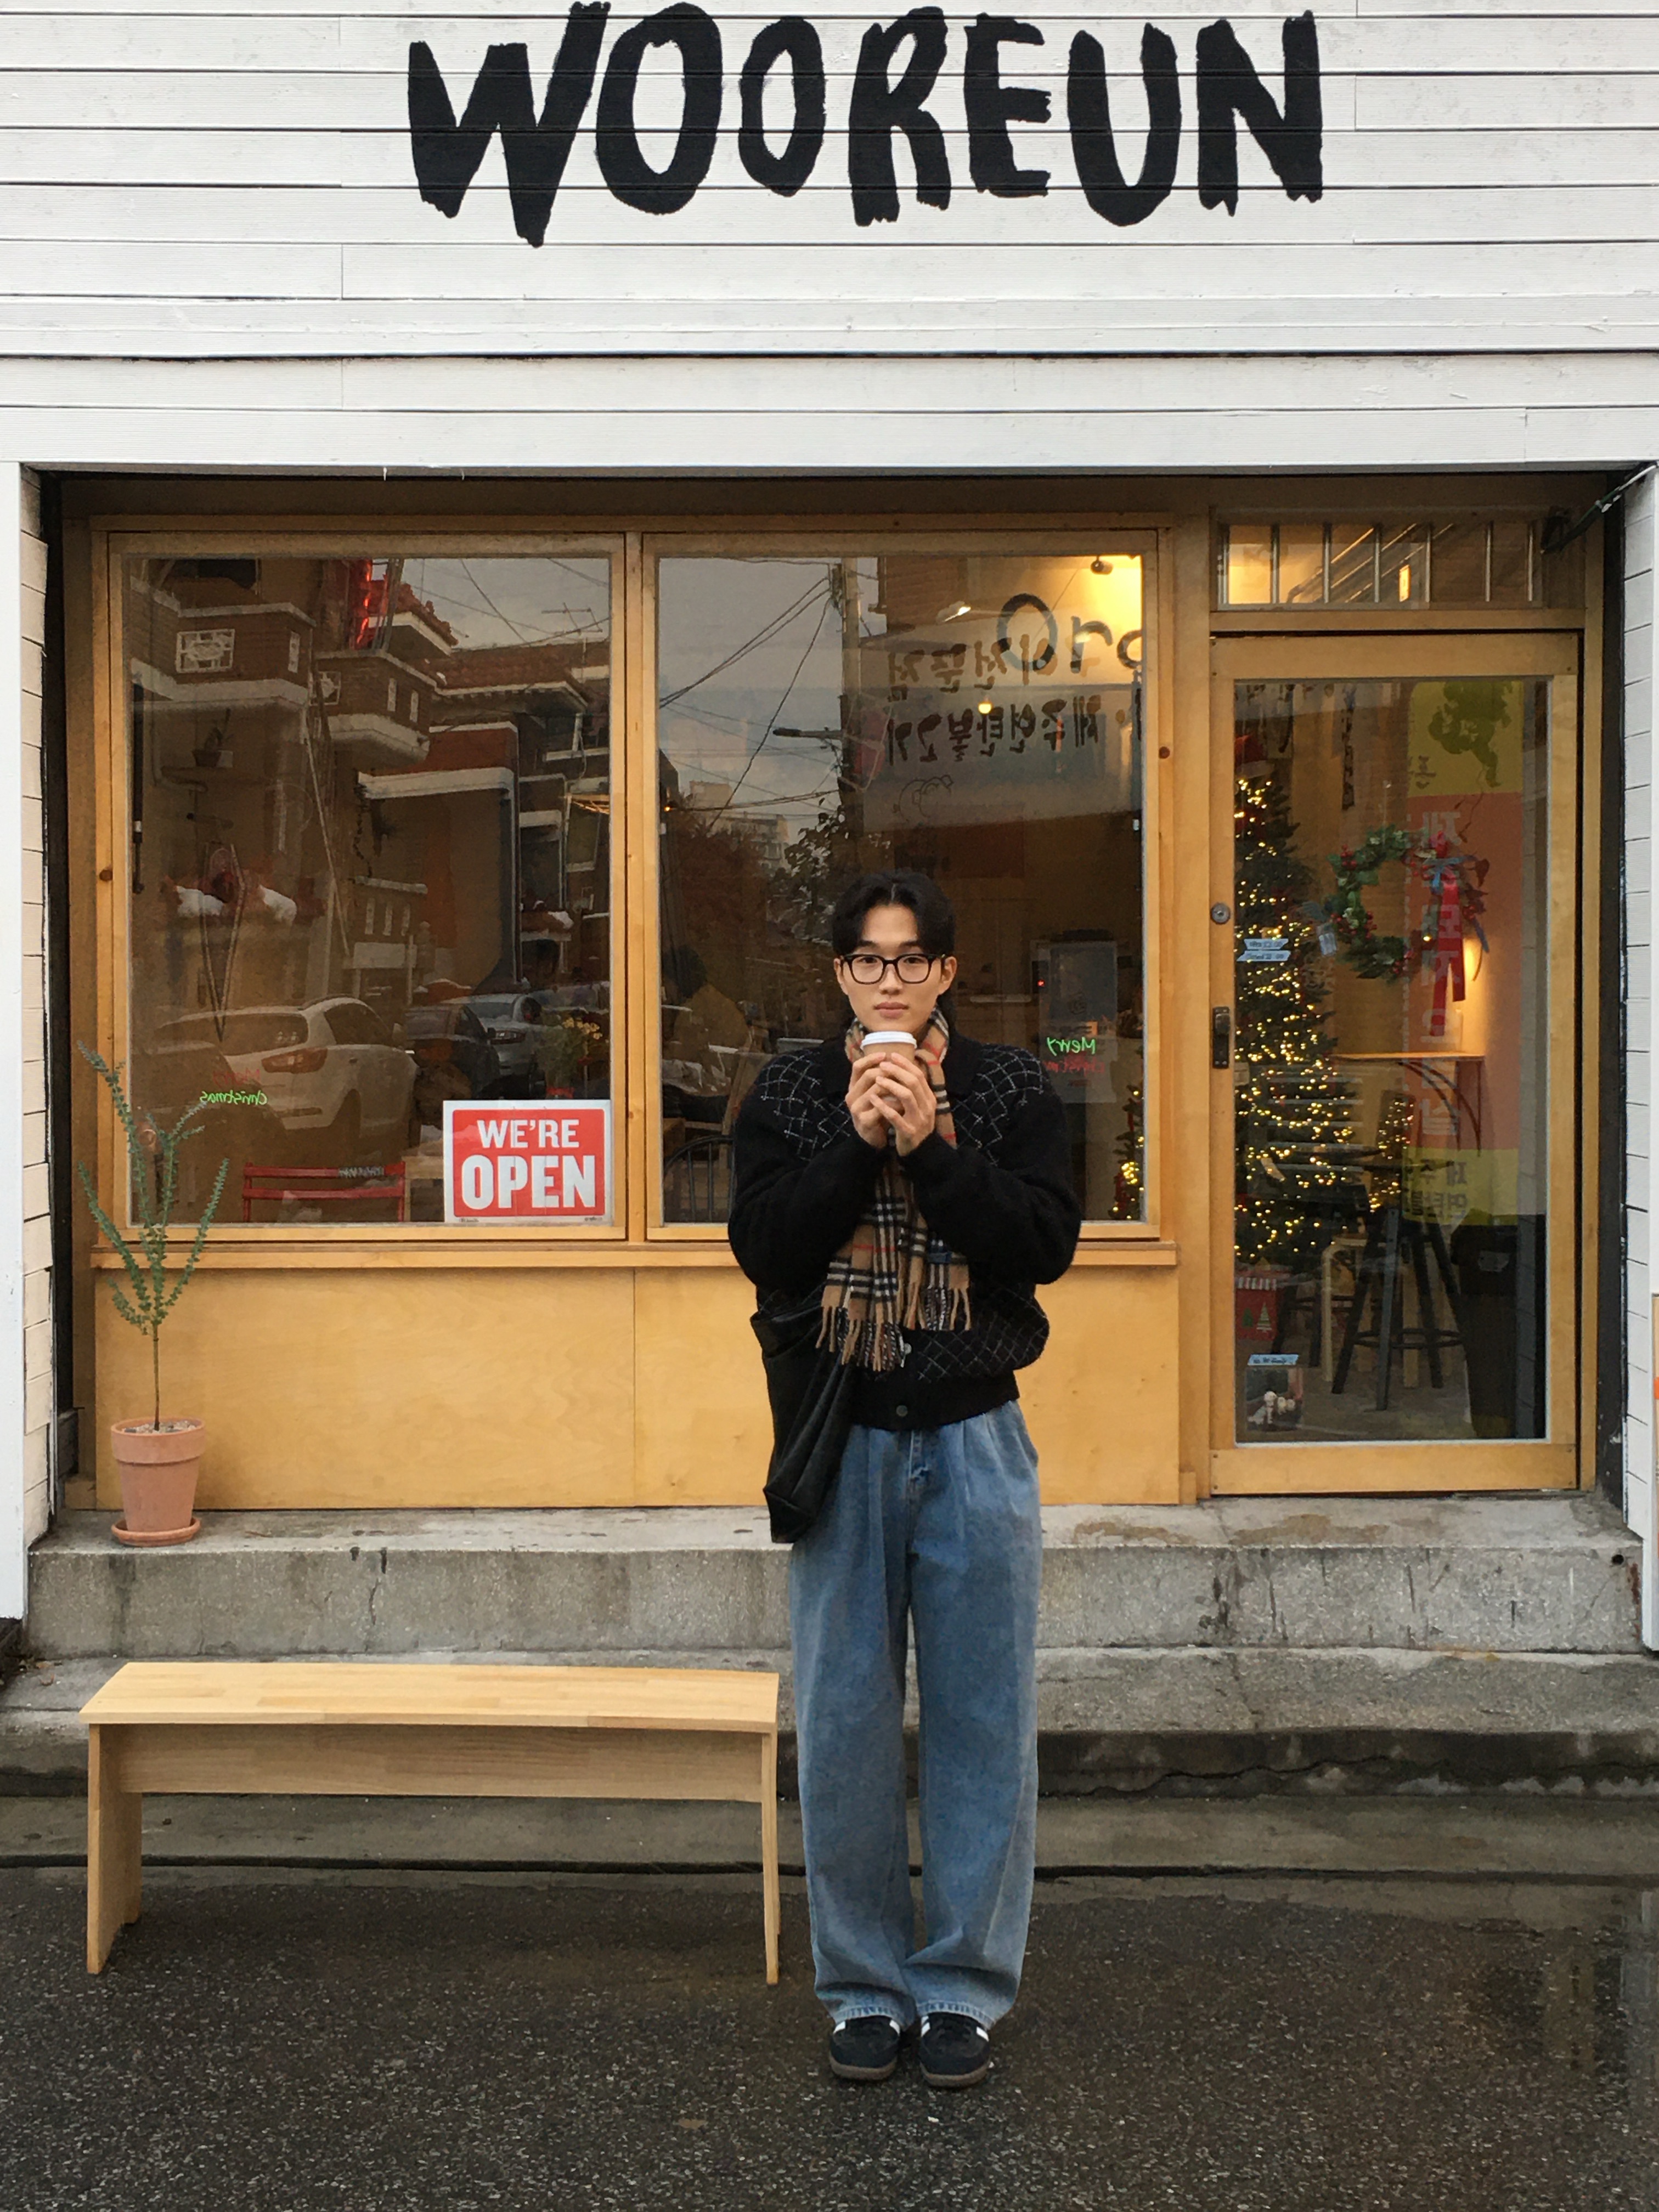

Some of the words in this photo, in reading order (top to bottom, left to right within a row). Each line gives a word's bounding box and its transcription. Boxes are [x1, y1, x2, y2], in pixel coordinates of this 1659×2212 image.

[408, 1, 1323, 247] WOOREUN
[477, 1119, 579, 1148] WE'RE
[461, 1155, 596, 1210] OPEN
